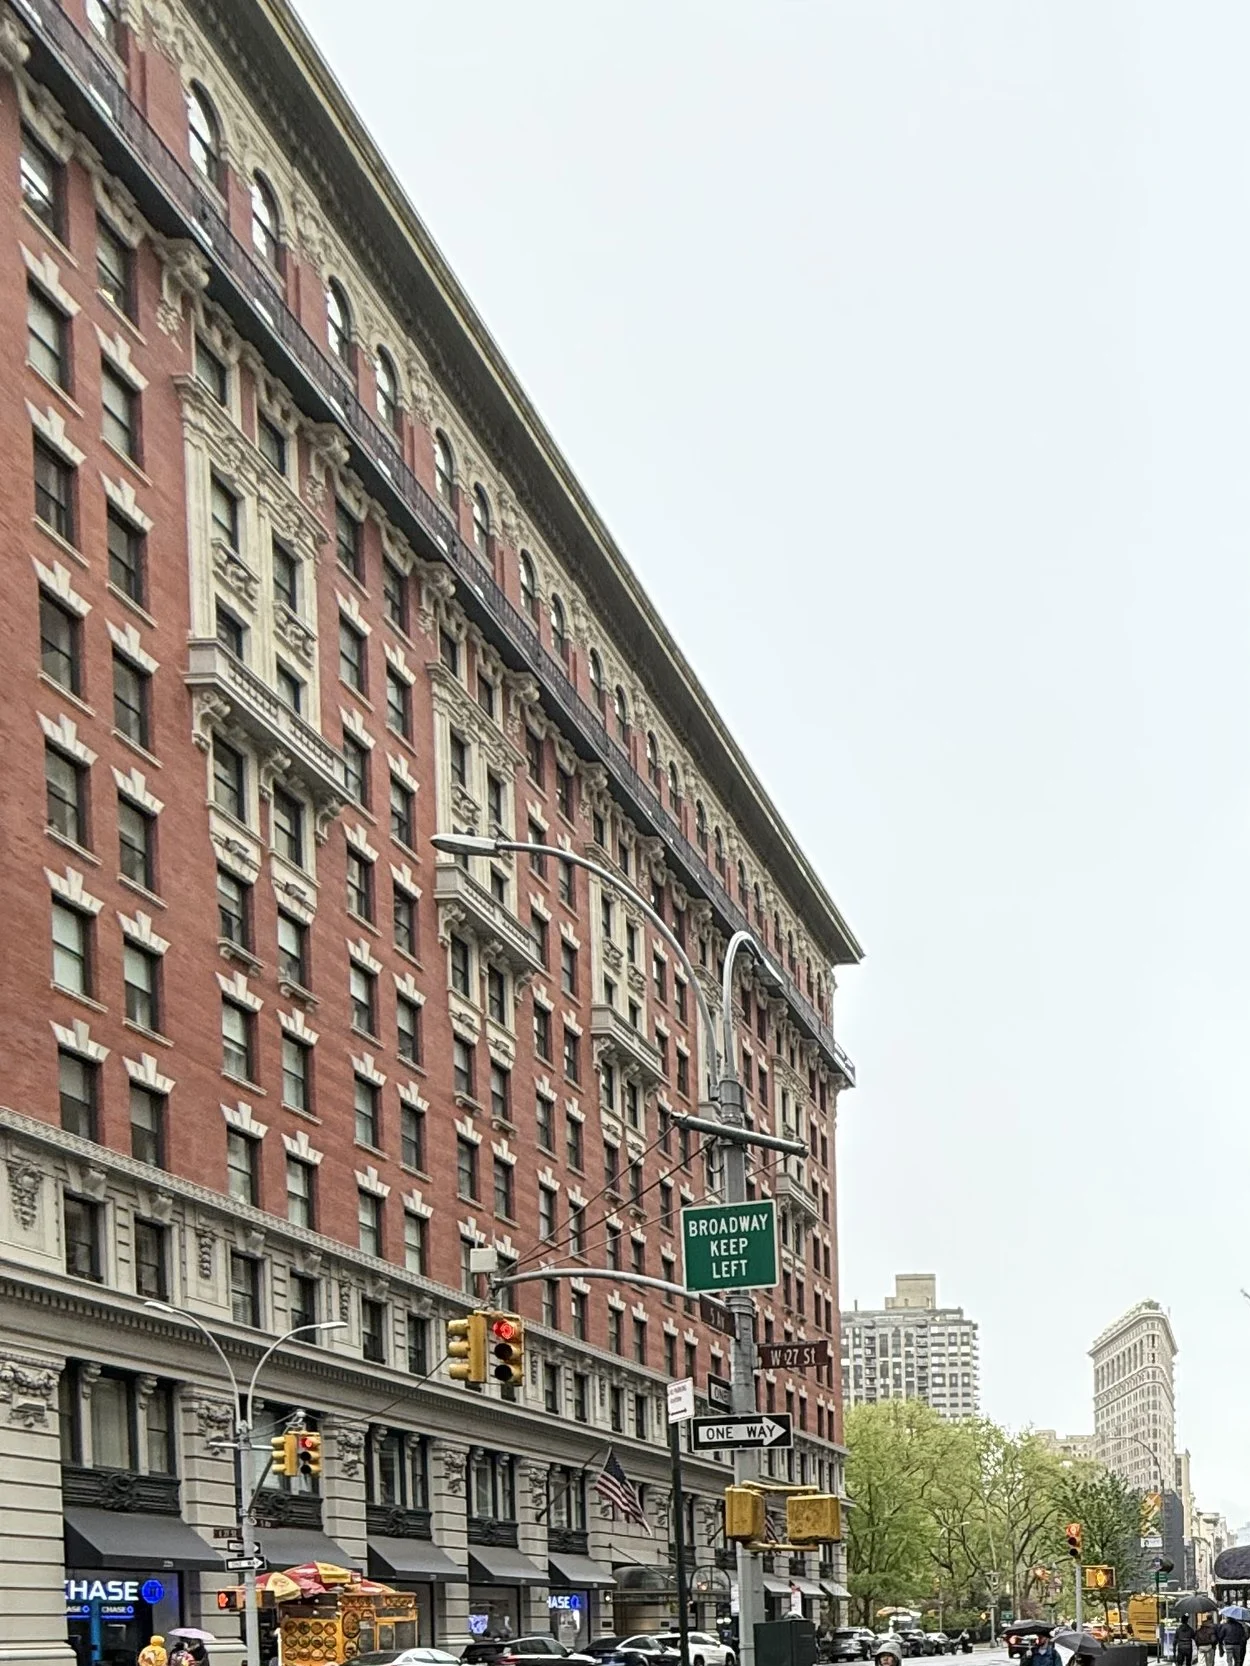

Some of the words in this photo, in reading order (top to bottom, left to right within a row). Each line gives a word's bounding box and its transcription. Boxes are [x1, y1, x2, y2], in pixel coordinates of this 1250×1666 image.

[688, 1213, 769, 1237] BROADWAY
[710, 1237, 748, 1257] KEEP
[712, 1260, 748, 1279] LEFT
[770, 1350, 782, 1366] W
[785, 1348, 799, 1365] 27
[803, 1348, 816, 1364] St
[706, 1426, 733, 1440] ONE
[746, 1424, 776, 1439] WAY
